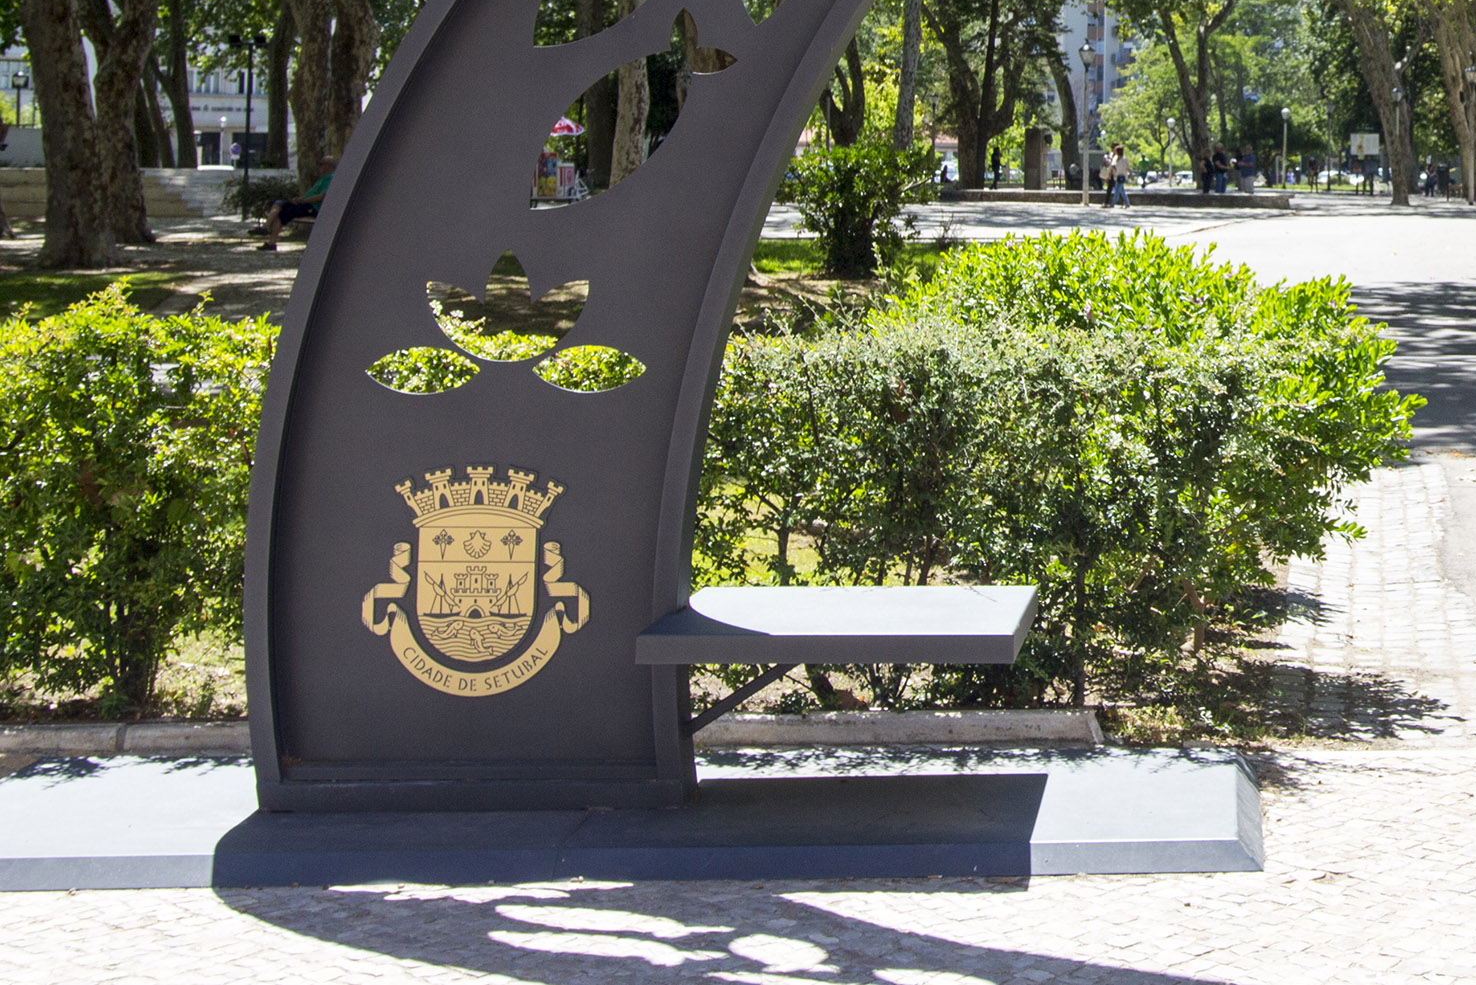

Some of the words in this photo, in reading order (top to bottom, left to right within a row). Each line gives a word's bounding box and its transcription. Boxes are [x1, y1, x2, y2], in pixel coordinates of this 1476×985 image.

[403, 647, 452, 687] CIDADE
[458, 678, 477, 691] DE
[484, 648, 548, 690] SETUBAL
